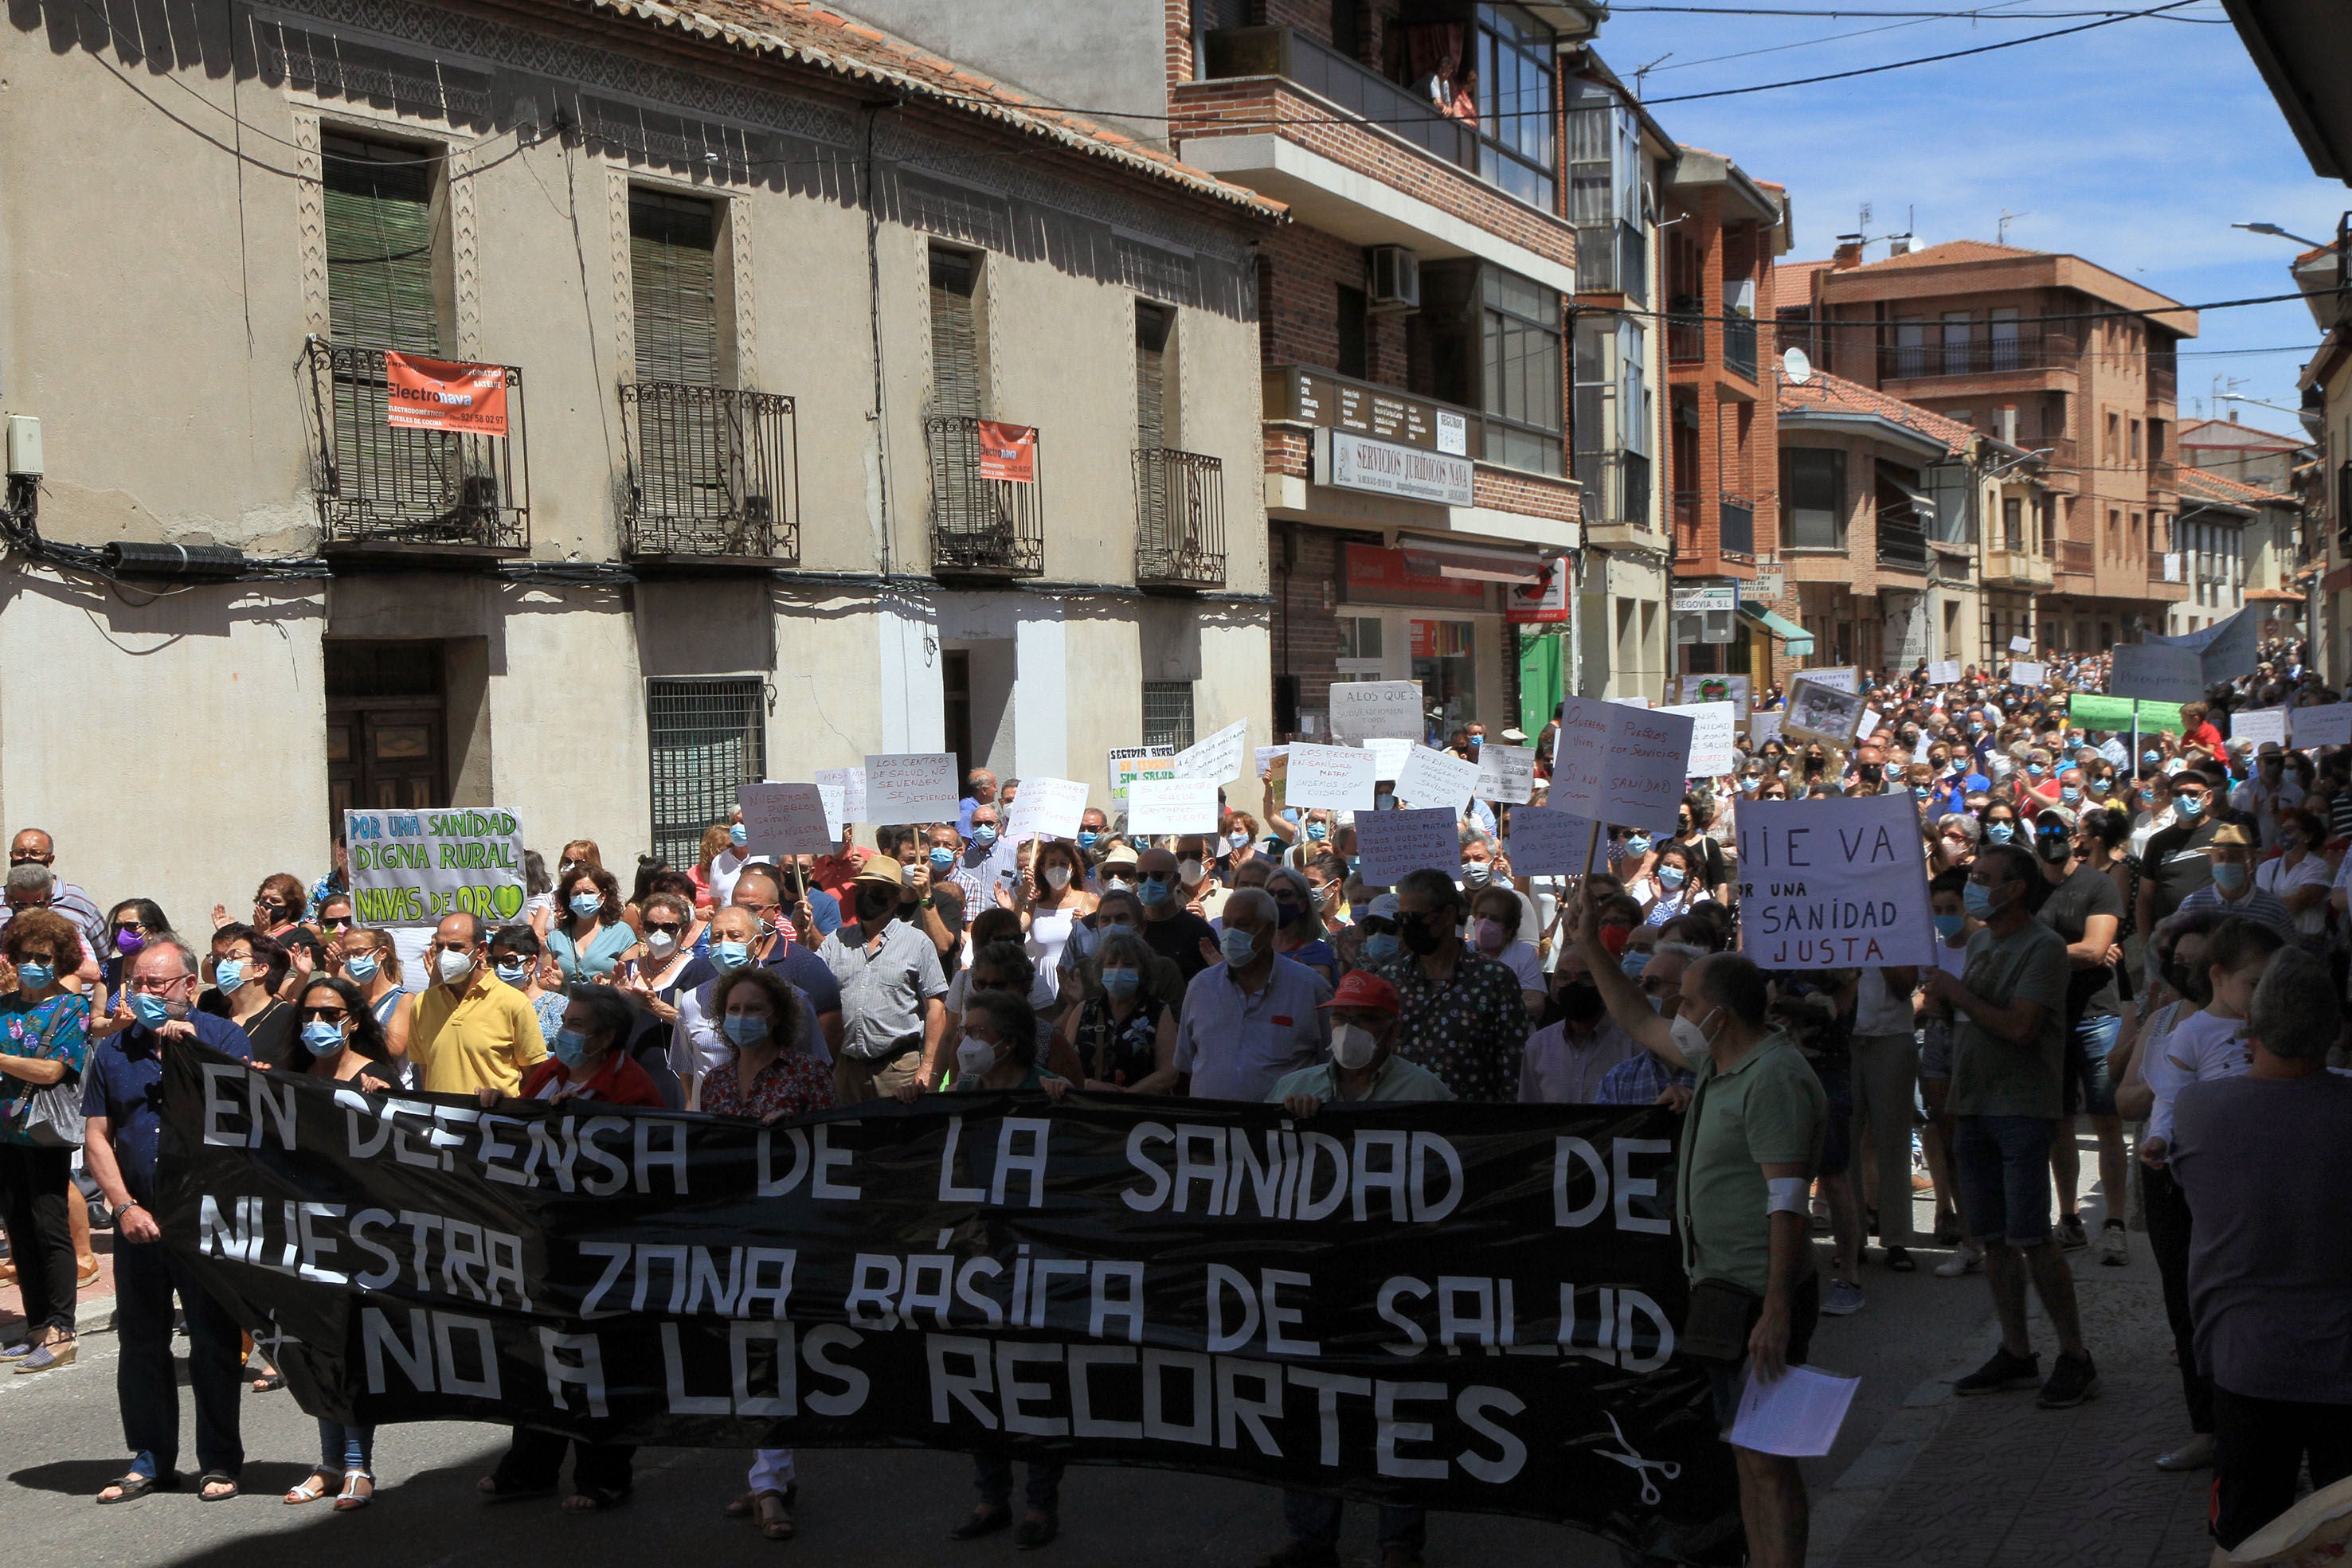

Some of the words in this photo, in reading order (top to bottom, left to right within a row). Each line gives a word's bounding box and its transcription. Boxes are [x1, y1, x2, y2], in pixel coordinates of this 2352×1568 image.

[388, 382, 472, 406] Electronava
[388, 415, 413, 424] MUEBLES
[495, 416, 504, 424] 97
[1440, 413, 1463, 429] SEGUROS
[1357, 444, 1402, 476] SERVICIOS
[1404, 451, 1446, 485] JURÍDICOS
[1450, 463, 1468, 487] NAVA
[1110, 748, 1147, 760] SEGOVIA
[1151, 746, 1173, 757] RURAL
[1300, 749, 1322, 757] LOS
[1325, 749, 1375, 761] RECORTES
[876, 759, 898, 768] LOS
[902, 757, 950, 768] CENTROS
[1291, 758, 1305, 767] EN
[871, 770, 886, 780] DE
[931, 767, 947, 776] NO
[1120, 772, 1137, 784] SIN
[1142, 771, 1175, 781] SALUD
[749, 792, 811, 806] NUESTROS
[886, 791, 904, 800] SE
[903, 792, 957, 804] DEFIENDEN
[767, 804, 816, 814] PUEBLOS
[1366, 815, 1387, 823] LOS
[1390, 811, 1445, 823] RECORTES
[350, 815, 382, 840] POR
[388, 815, 422, 837] UNA
[1423, 821, 1454, 830] MATAN
[1395, 834, 1442, 843] NUESTROS
[438, 842, 519, 870] RURAL
[1361, 846, 1395, 854] PUEBLOS
[1376, 854, 1416, 863] NUESTRA
[1376, 862, 1430, 876] LUCHEMOS
[1771, 882, 1807, 897] UNA
[355, 886, 423, 923] NAVAS
[429, 891, 452, 917] DE
[1774, 936, 1884, 964] JUSTA
[201, 1062, 297, 1150] EN
[333, 1089, 691, 1196] DEFENSA
[757, 1119, 862, 1201] DE
[938, 1116, 1051, 1208] LA
[1553, 1135, 1672, 1236] DE
[199, 1195, 534, 1312] NUESTRA
[1206, 1263, 1321, 1356] DE
[1375, 1275, 1675, 1374] SALUD
[361, 1307, 503, 1400] NO
[530, 1325, 610, 1418] A
[659, 1319, 871, 1417] LOS
[926, 1331, 1527, 1484] RECORTES
